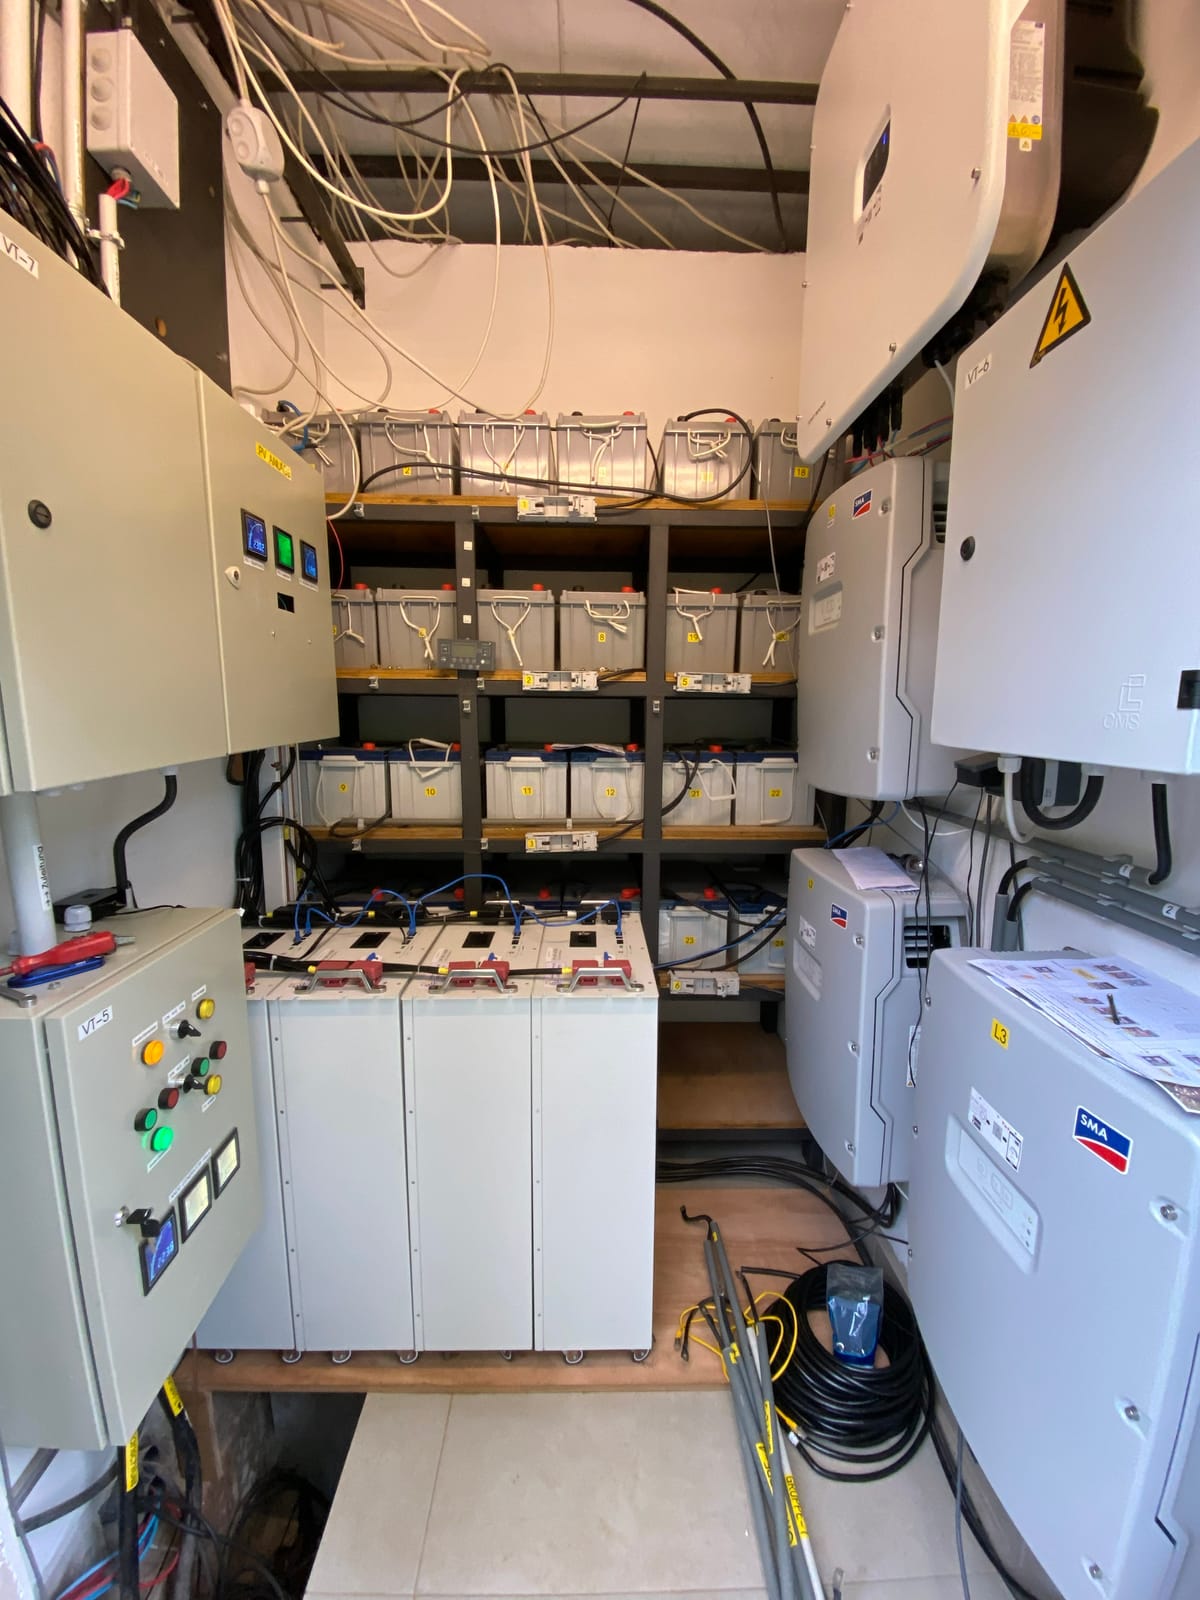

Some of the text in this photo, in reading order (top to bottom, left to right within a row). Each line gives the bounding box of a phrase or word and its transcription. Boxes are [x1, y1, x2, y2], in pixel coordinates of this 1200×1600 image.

[3, 236, 35, 272] VT-7
[967, 359, 990, 384] VT-6
[796, 468, 807, 477] 18
[854, 496, 865, 506] SMA
[689, 633, 698, 641] 19
[526, 676, 532, 684] 2
[682, 678, 688, 686] 5
[426, 788, 436, 796] 10
[523, 787, 532, 795] 11
[606, 788, 615, 796] 12
[770, 789, 781, 797] 22
[1165, 905, 1174, 915] 2
[81, 1009, 110, 1035] VT-5
[993, 1022, 1008, 1045] L3
[1080, 1113, 1108, 1141] SMA
